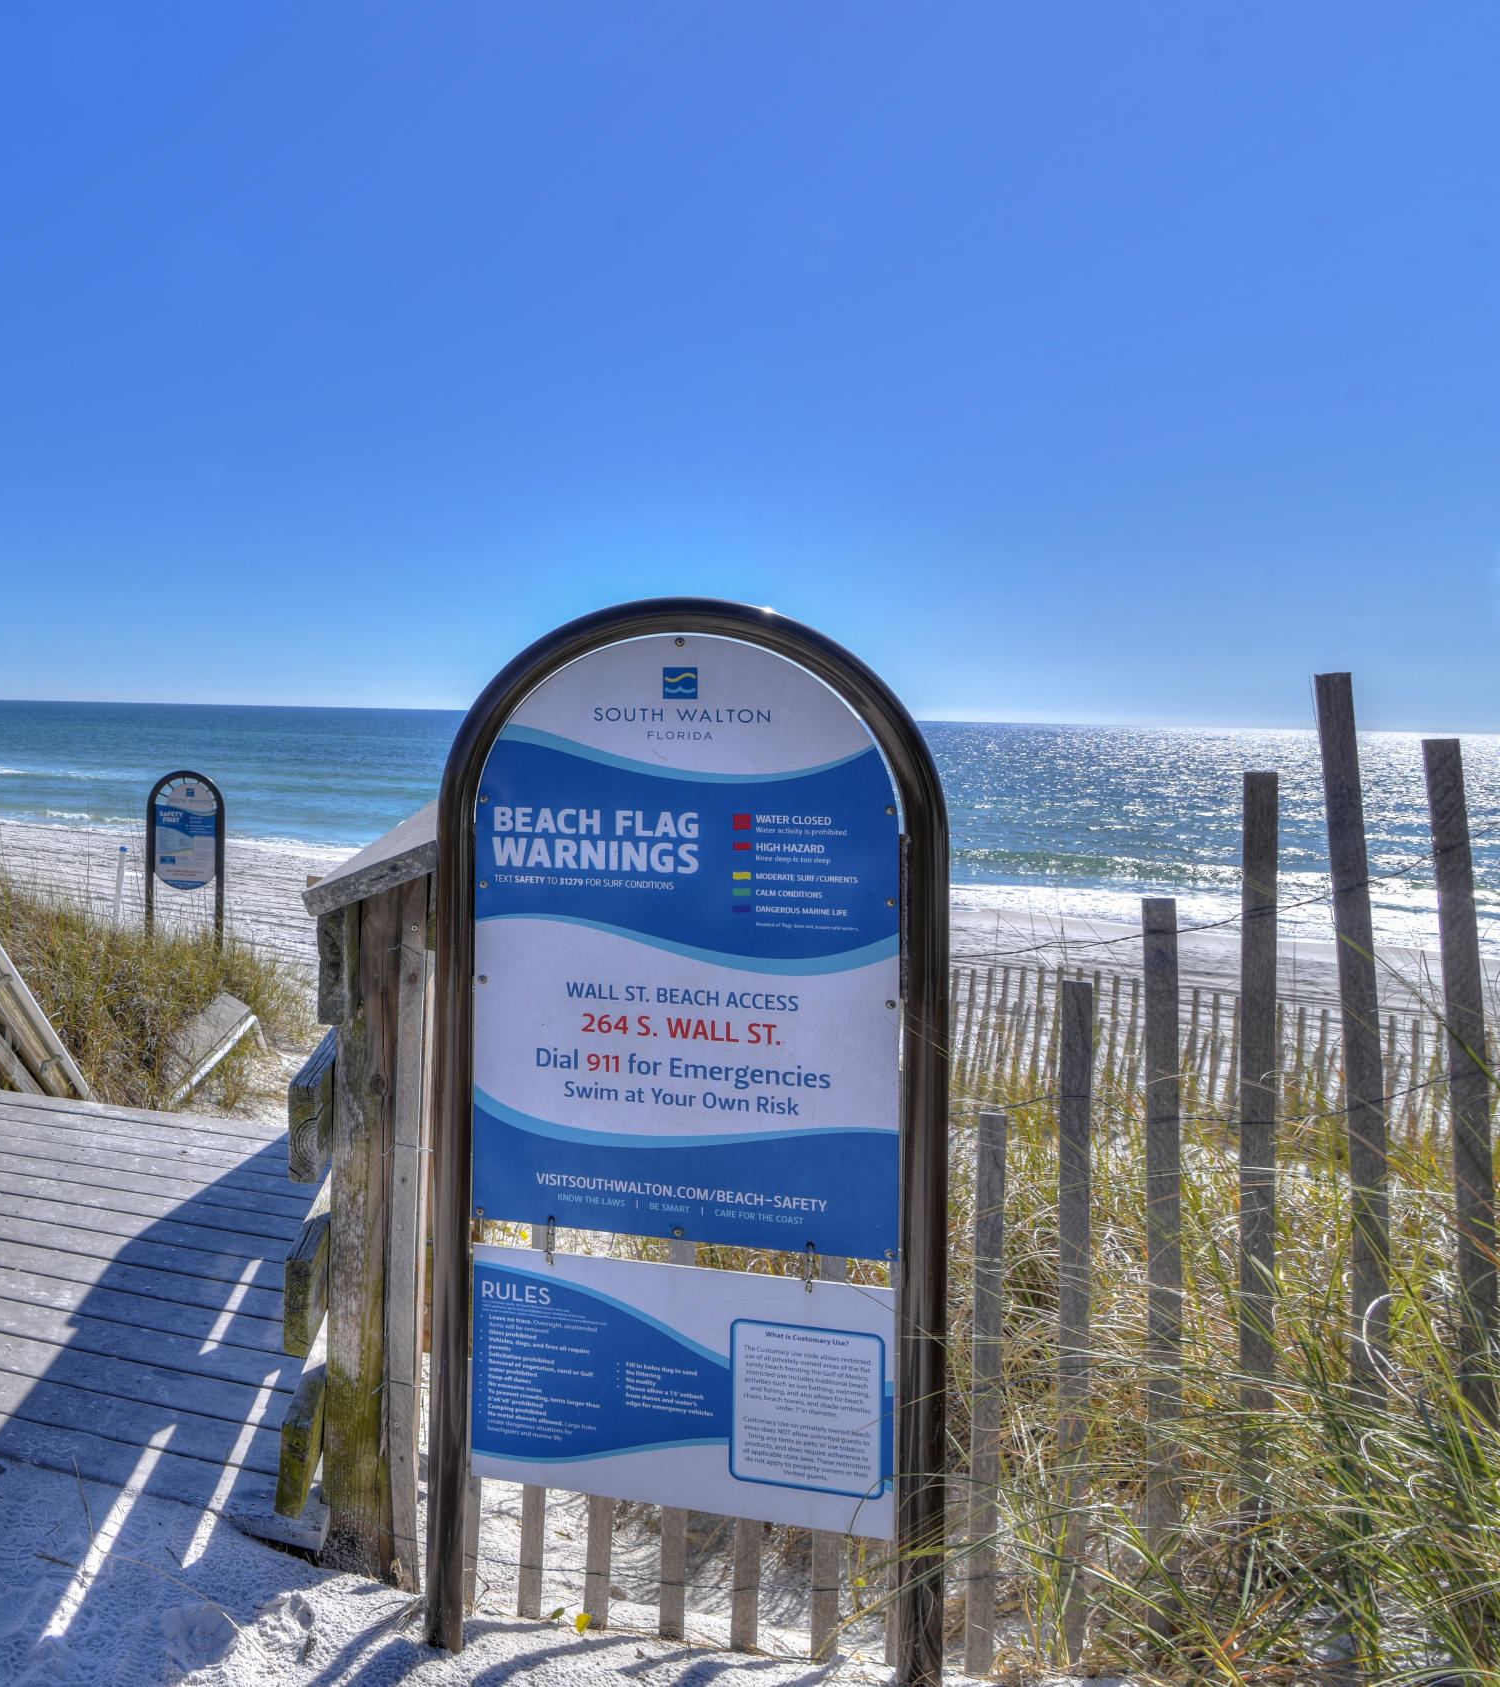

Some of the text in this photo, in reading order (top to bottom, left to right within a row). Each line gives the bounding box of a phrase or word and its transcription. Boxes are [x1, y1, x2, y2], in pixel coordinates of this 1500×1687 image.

[594, 707, 770, 723] SOUTH WALTON
[648, 731, 712, 740] FLORIDA
[494, 807, 698, 838] BEACH FLAG
[756, 815, 831, 825] WATER CLOSED
[756, 843, 824, 853] HIGH HAZARD
[492, 837, 698, 874] WARNINGS
[814, 857, 831, 865] deep
[515, 875, 545, 884] SAFETY
[625, 880, 673, 889] CONDITIONS
[797, 875, 858, 883] SURF/CURRENTS
[566, 982, 798, 1011] WALL ST. BEACH ACCESS
[581, 1013, 781, 1045] 264 S. WALL ST.
[537, 1048, 830, 1089] Dial 911 for Emergencies
[564, 1081, 798, 1115] Swim at Your Own Risk
[536, 1173, 827, 1212] VISITSOUTHWALTON.COM/BEACH-SAFETY
[558, 1193, 625, 1206] KNOW THE LAWS
[662, 1204, 690, 1213] SMART
[715, 1209, 804, 1224] CARE FOR THE COAST
[482, 1281, 550, 1304] RULES
[533, 1320, 563, 1328] Overnight,
[489, 1336, 514, 1345] Vehicles,
[793, 1335, 830, 1345] Customary
[489, 1352, 522, 1360] Solicitation
[757, 1346, 790, 1356] Customary
[636, 1371, 661, 1380] littering
[520, 1394, 549, 1402] crowding,
[488, 1403, 514, 1412] Camping
[652, 1405, 687, 1414] emergency
